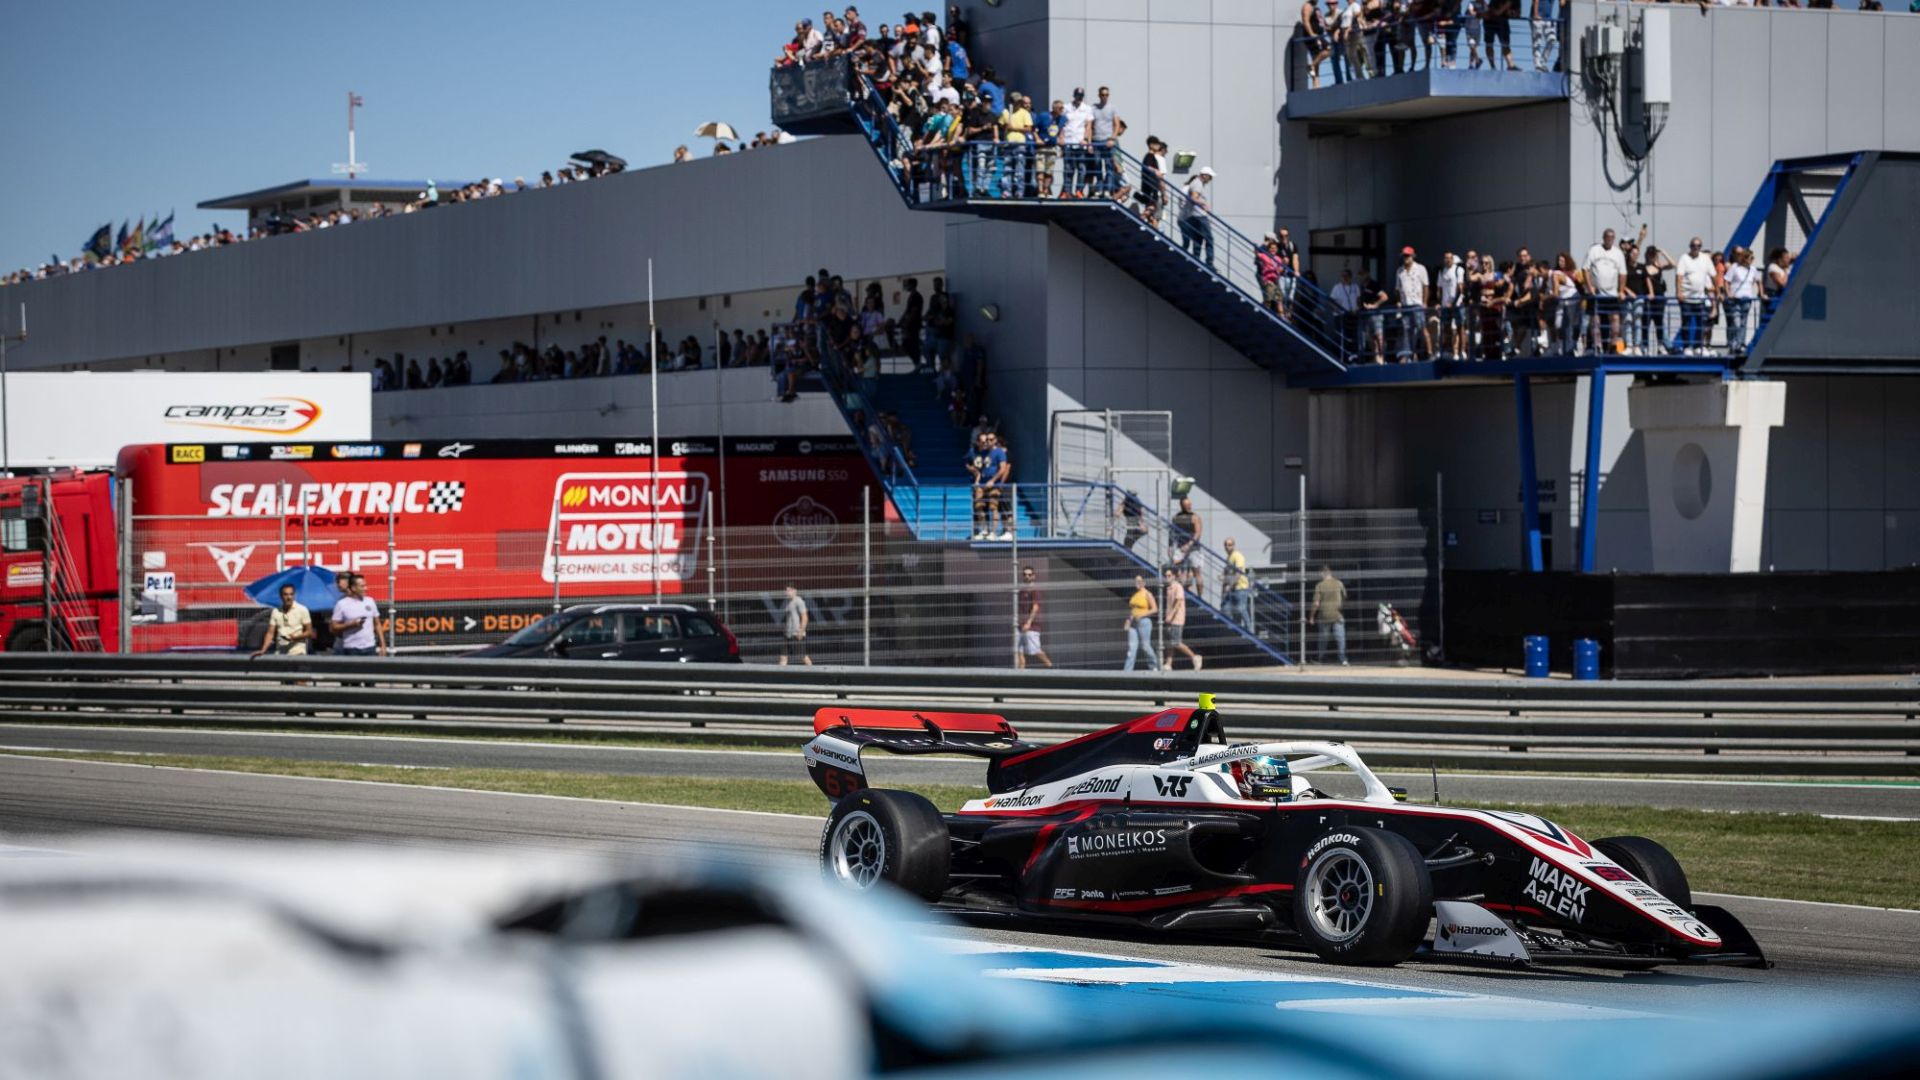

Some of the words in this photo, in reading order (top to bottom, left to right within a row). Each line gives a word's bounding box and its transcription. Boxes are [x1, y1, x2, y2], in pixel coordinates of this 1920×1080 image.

[175, 450, 202, 459] RACC
[624, 442, 652, 455] Beta
[759, 469, 826, 482] SAMSUNG
[206, 481, 430, 516] SCALEXTRIC
[589, 485, 697, 507] MONLAU
[288, 516, 349, 528] RACING
[566, 523, 681, 551] MOTUL
[276, 548, 464, 572] CUPRA
[1198, 746, 1258, 765] MARKOGIANNIS
[1081, 829, 1166, 852] MONEIKOS
[1528, 856, 1593, 907] MARK
[1522, 879, 1585, 925] AaLEN
